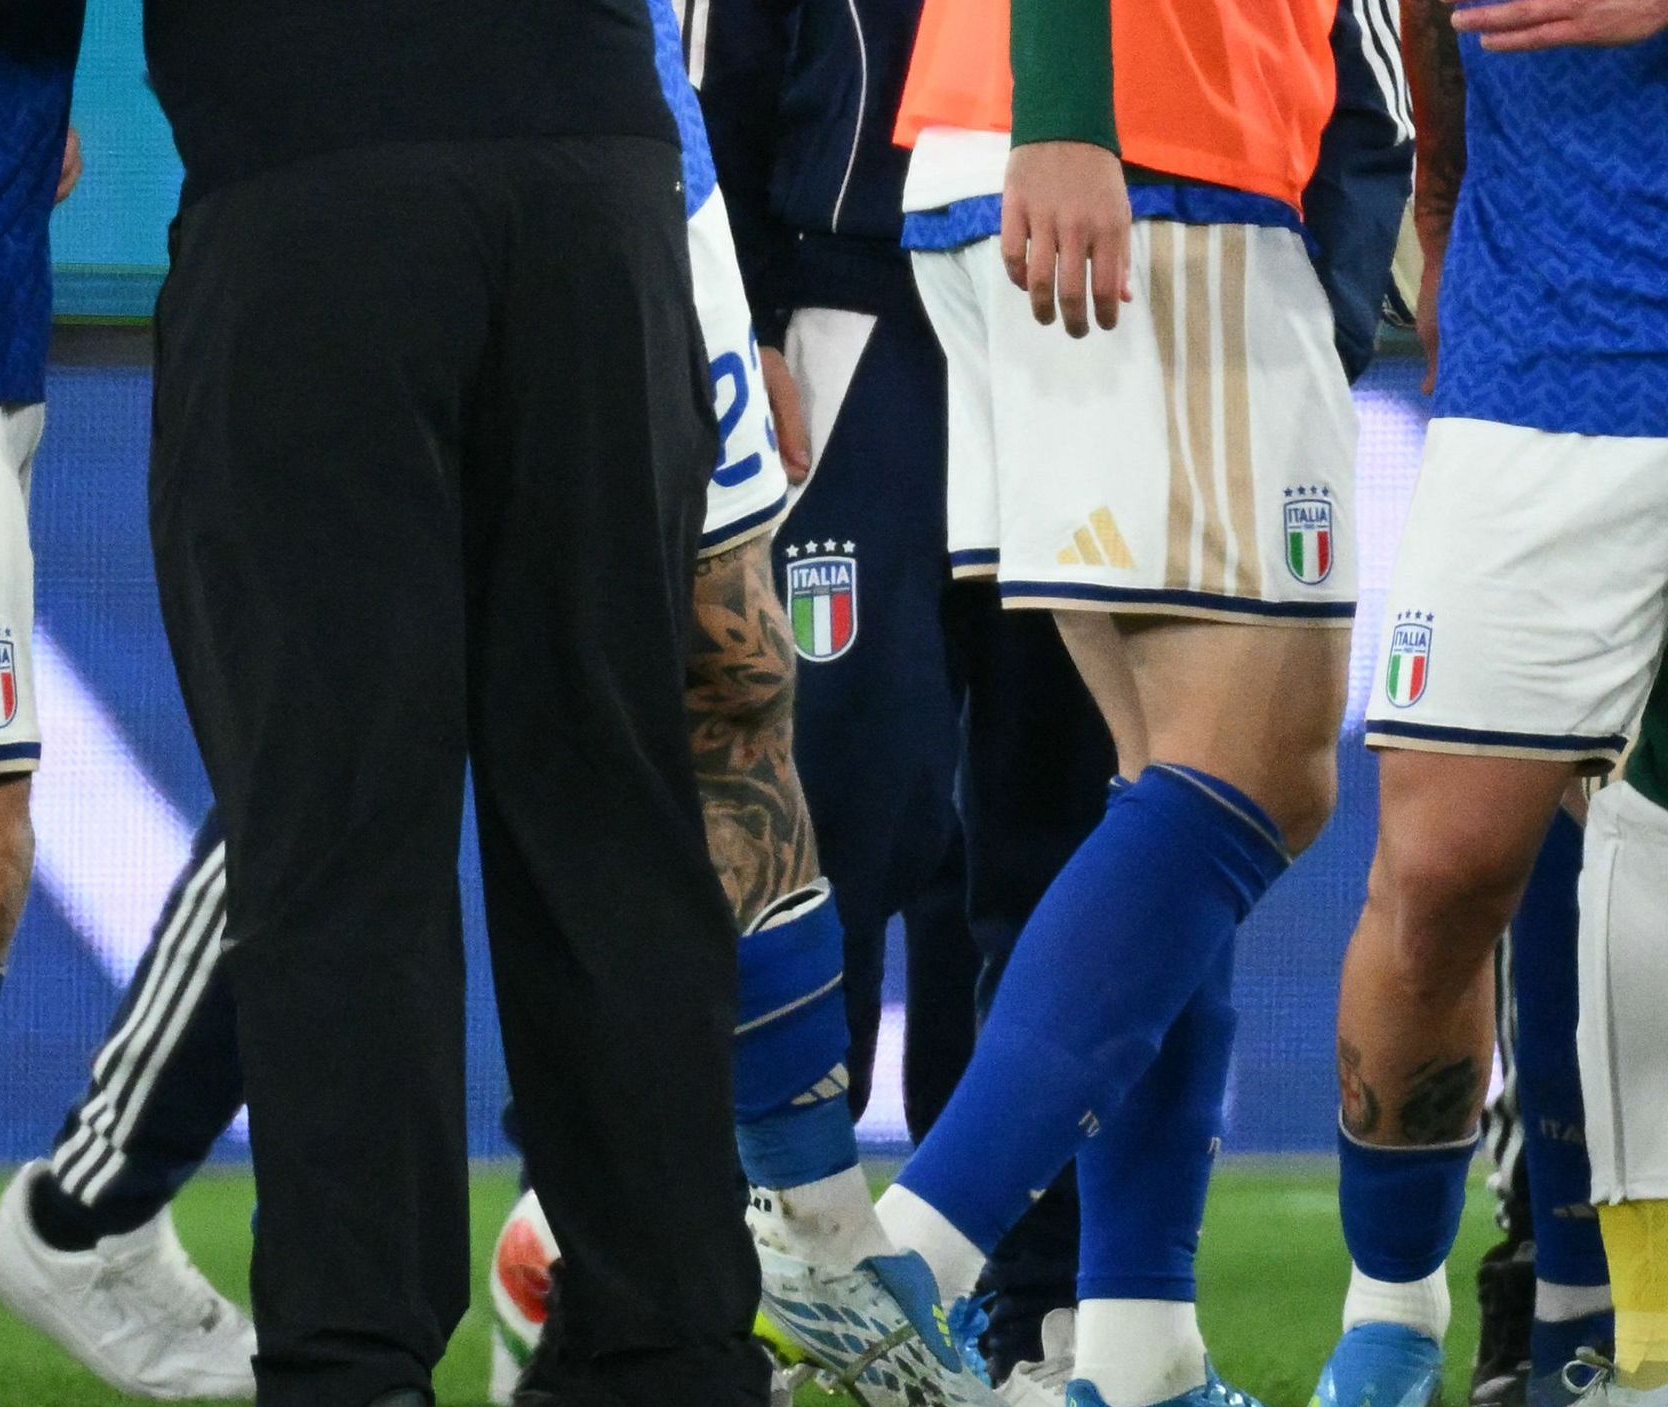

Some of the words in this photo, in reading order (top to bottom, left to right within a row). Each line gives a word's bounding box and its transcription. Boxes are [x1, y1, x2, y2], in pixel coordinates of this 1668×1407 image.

[1288, 507, 1328, 523] ITALIA
[792, 564, 851, 589] ITALIA
[1395, 631, 1427, 647] ITALIA
